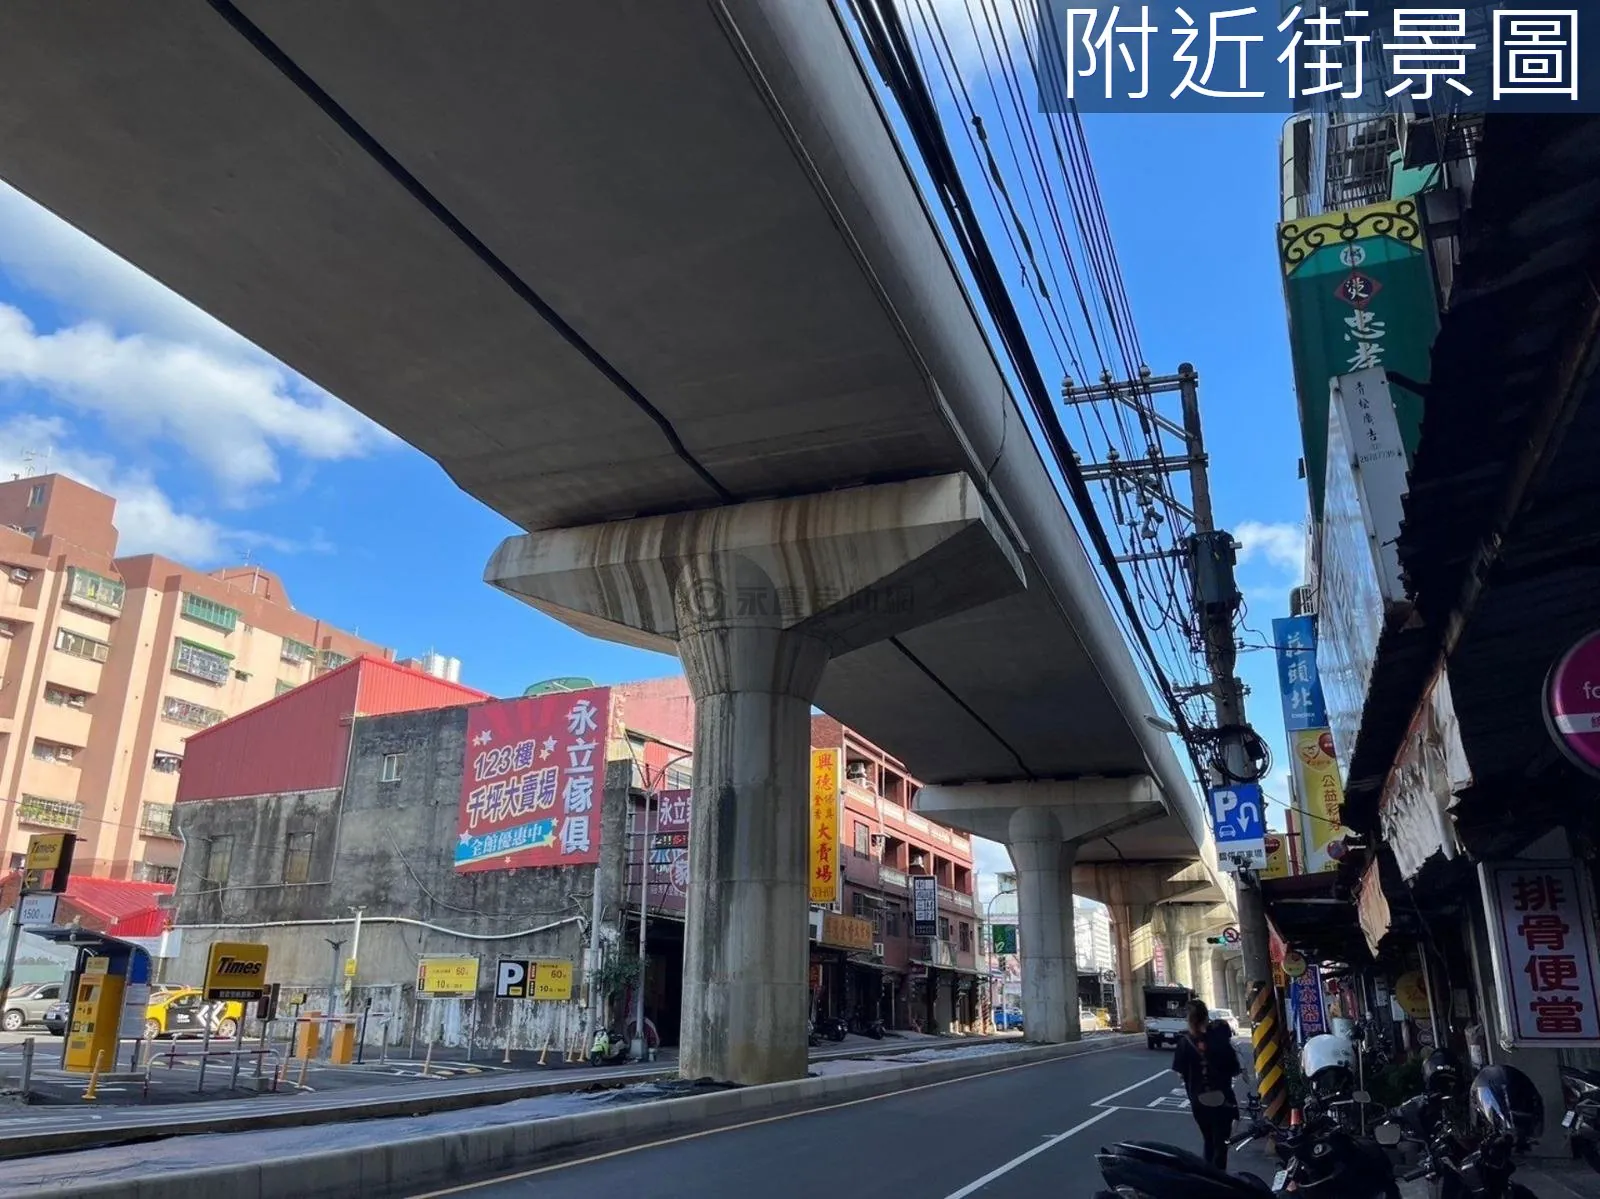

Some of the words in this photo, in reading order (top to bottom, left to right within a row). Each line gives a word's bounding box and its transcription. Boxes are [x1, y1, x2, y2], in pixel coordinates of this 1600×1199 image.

[473, 739, 536, 782] 123樓
[559, 699, 599, 855] 永立傢俱
[466, 766, 559, 829] 千坪大賣場
[1214, 791, 1238, 822] P
[471, 823, 544, 857] 全館優惠中
[815, 822, 833, 886] 大賣場
[217, 956, 262, 975] Times
[1511, 874, 1584, 1033] 排骨便當
[498, 962, 524, 995] P
